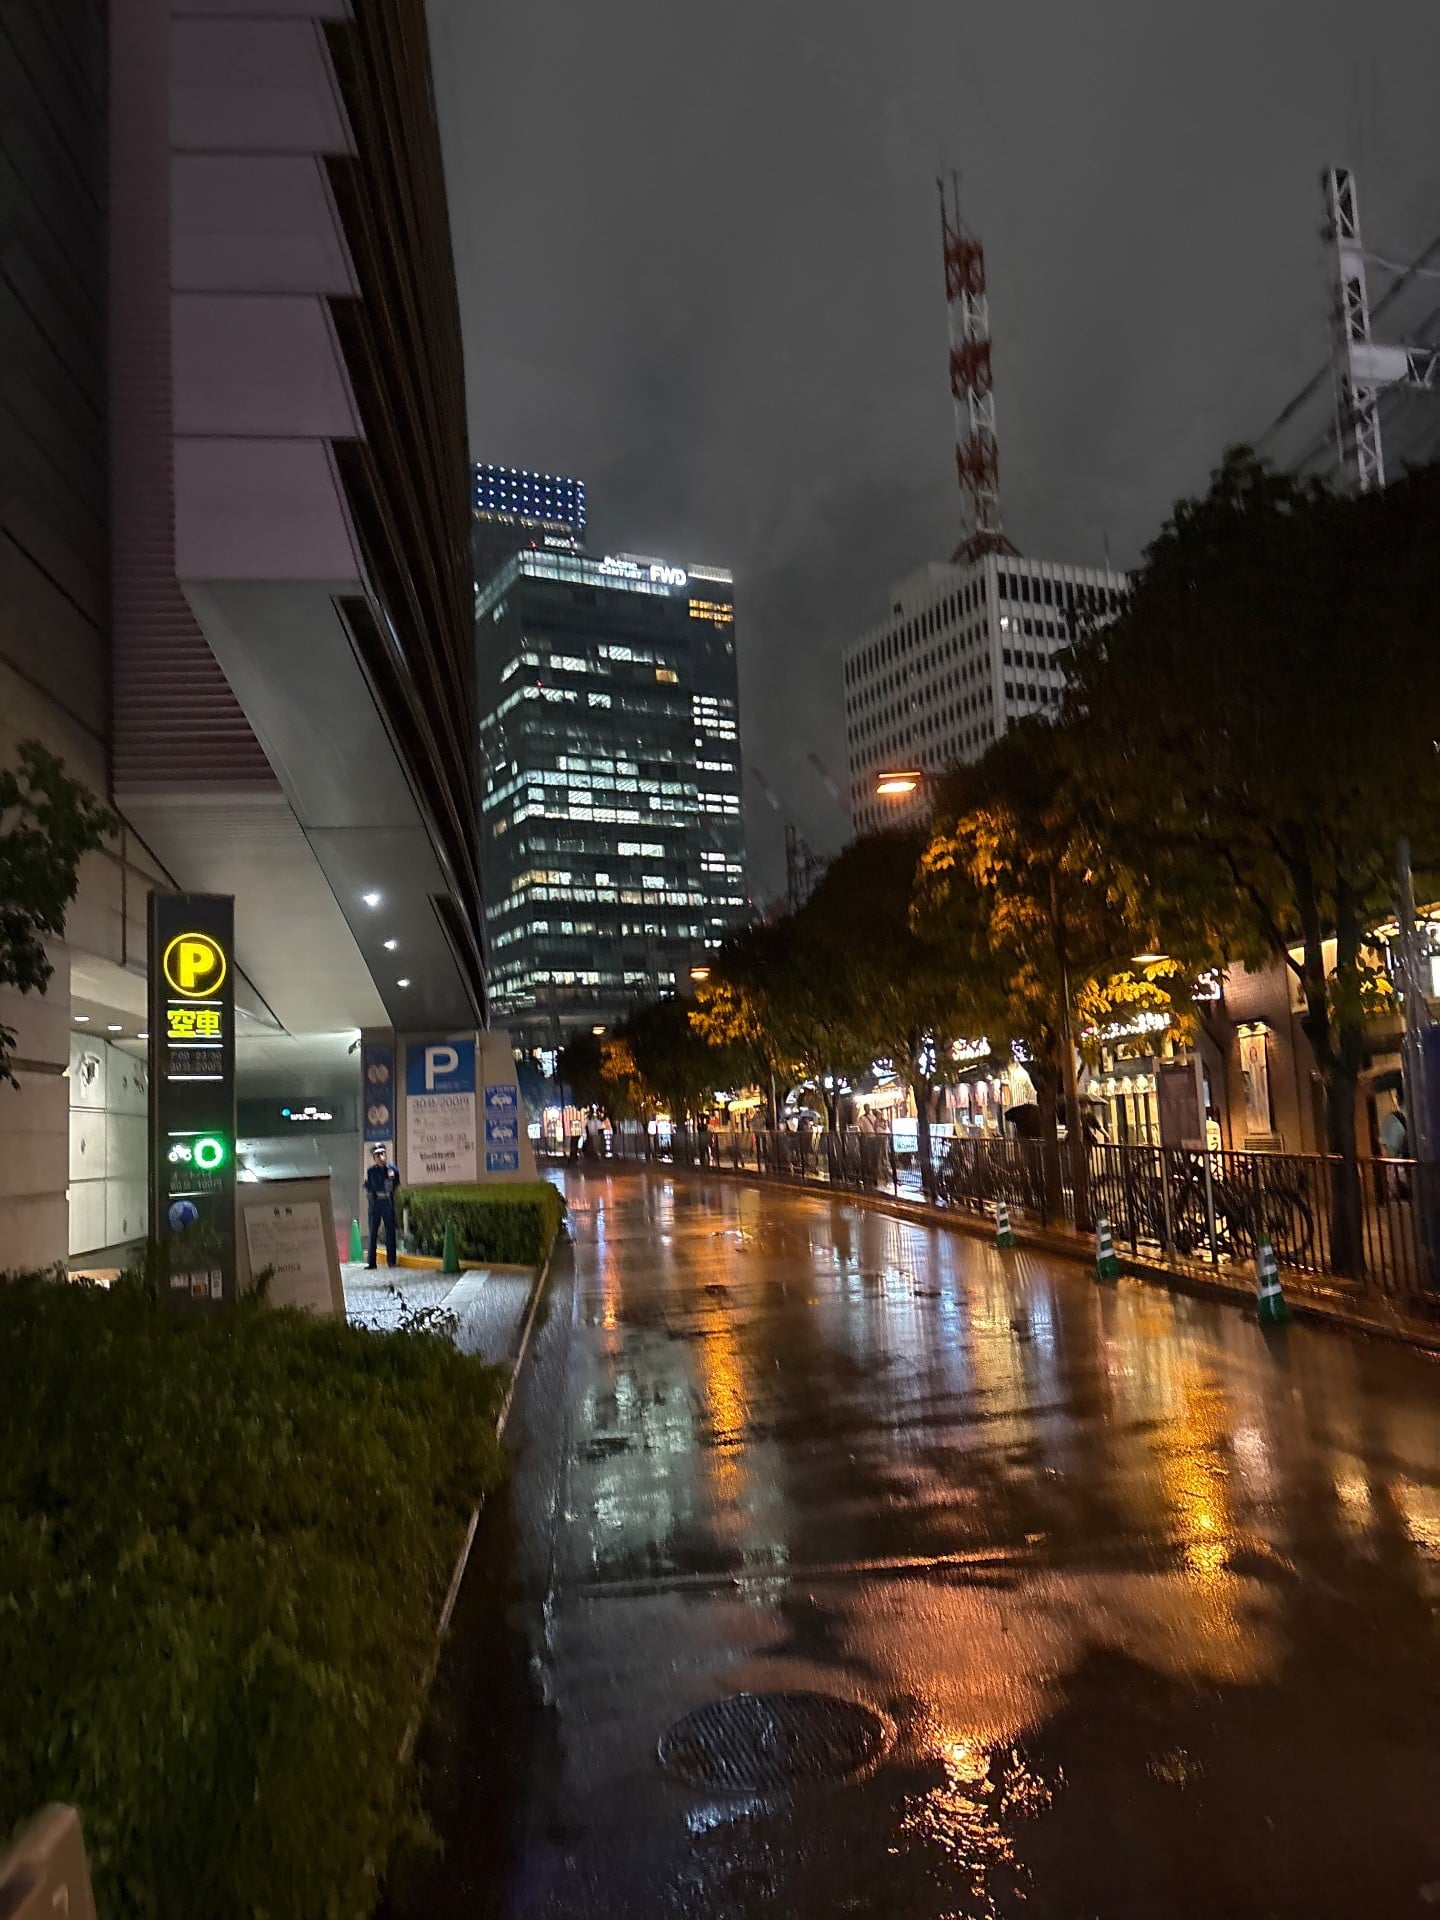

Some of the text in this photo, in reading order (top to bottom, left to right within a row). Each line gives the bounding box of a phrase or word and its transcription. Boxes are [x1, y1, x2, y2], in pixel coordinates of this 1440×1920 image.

[598, 563, 642, 579] CENTURY
[650, 565, 687, 586] FWD
[178, 942, 215, 988] P
[167, 1009, 221, 1038] 空車
[425, 1046, 459, 1090] P
